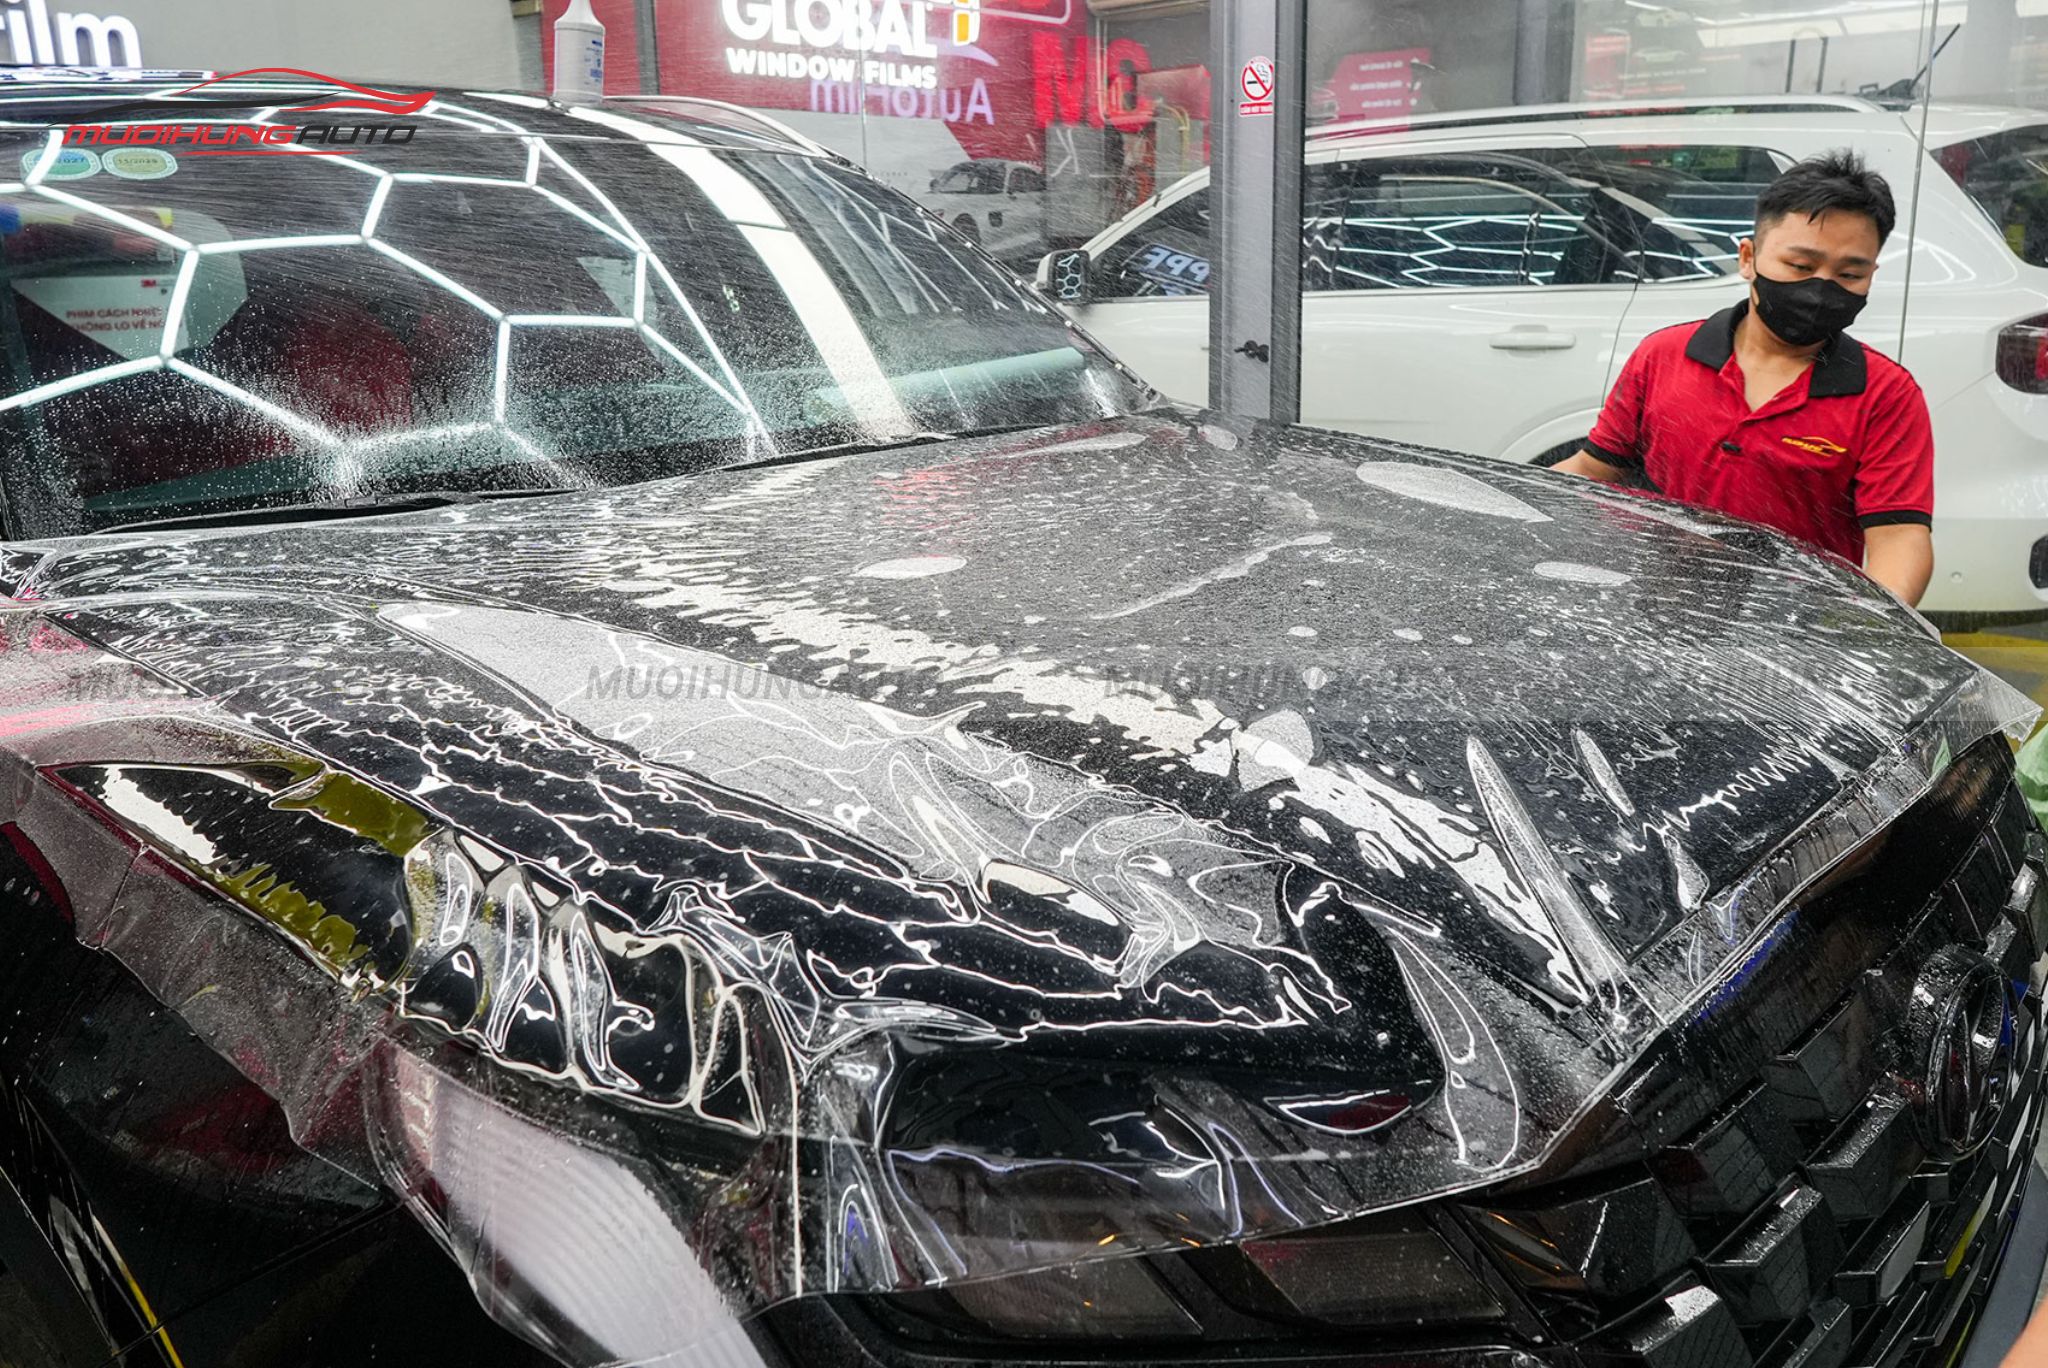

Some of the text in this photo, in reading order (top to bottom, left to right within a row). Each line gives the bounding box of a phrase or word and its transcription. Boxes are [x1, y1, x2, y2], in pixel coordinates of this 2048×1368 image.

[721, 0, 938, 58] GLOBAL
[725, 47, 938, 89] WINDOW FILMS
